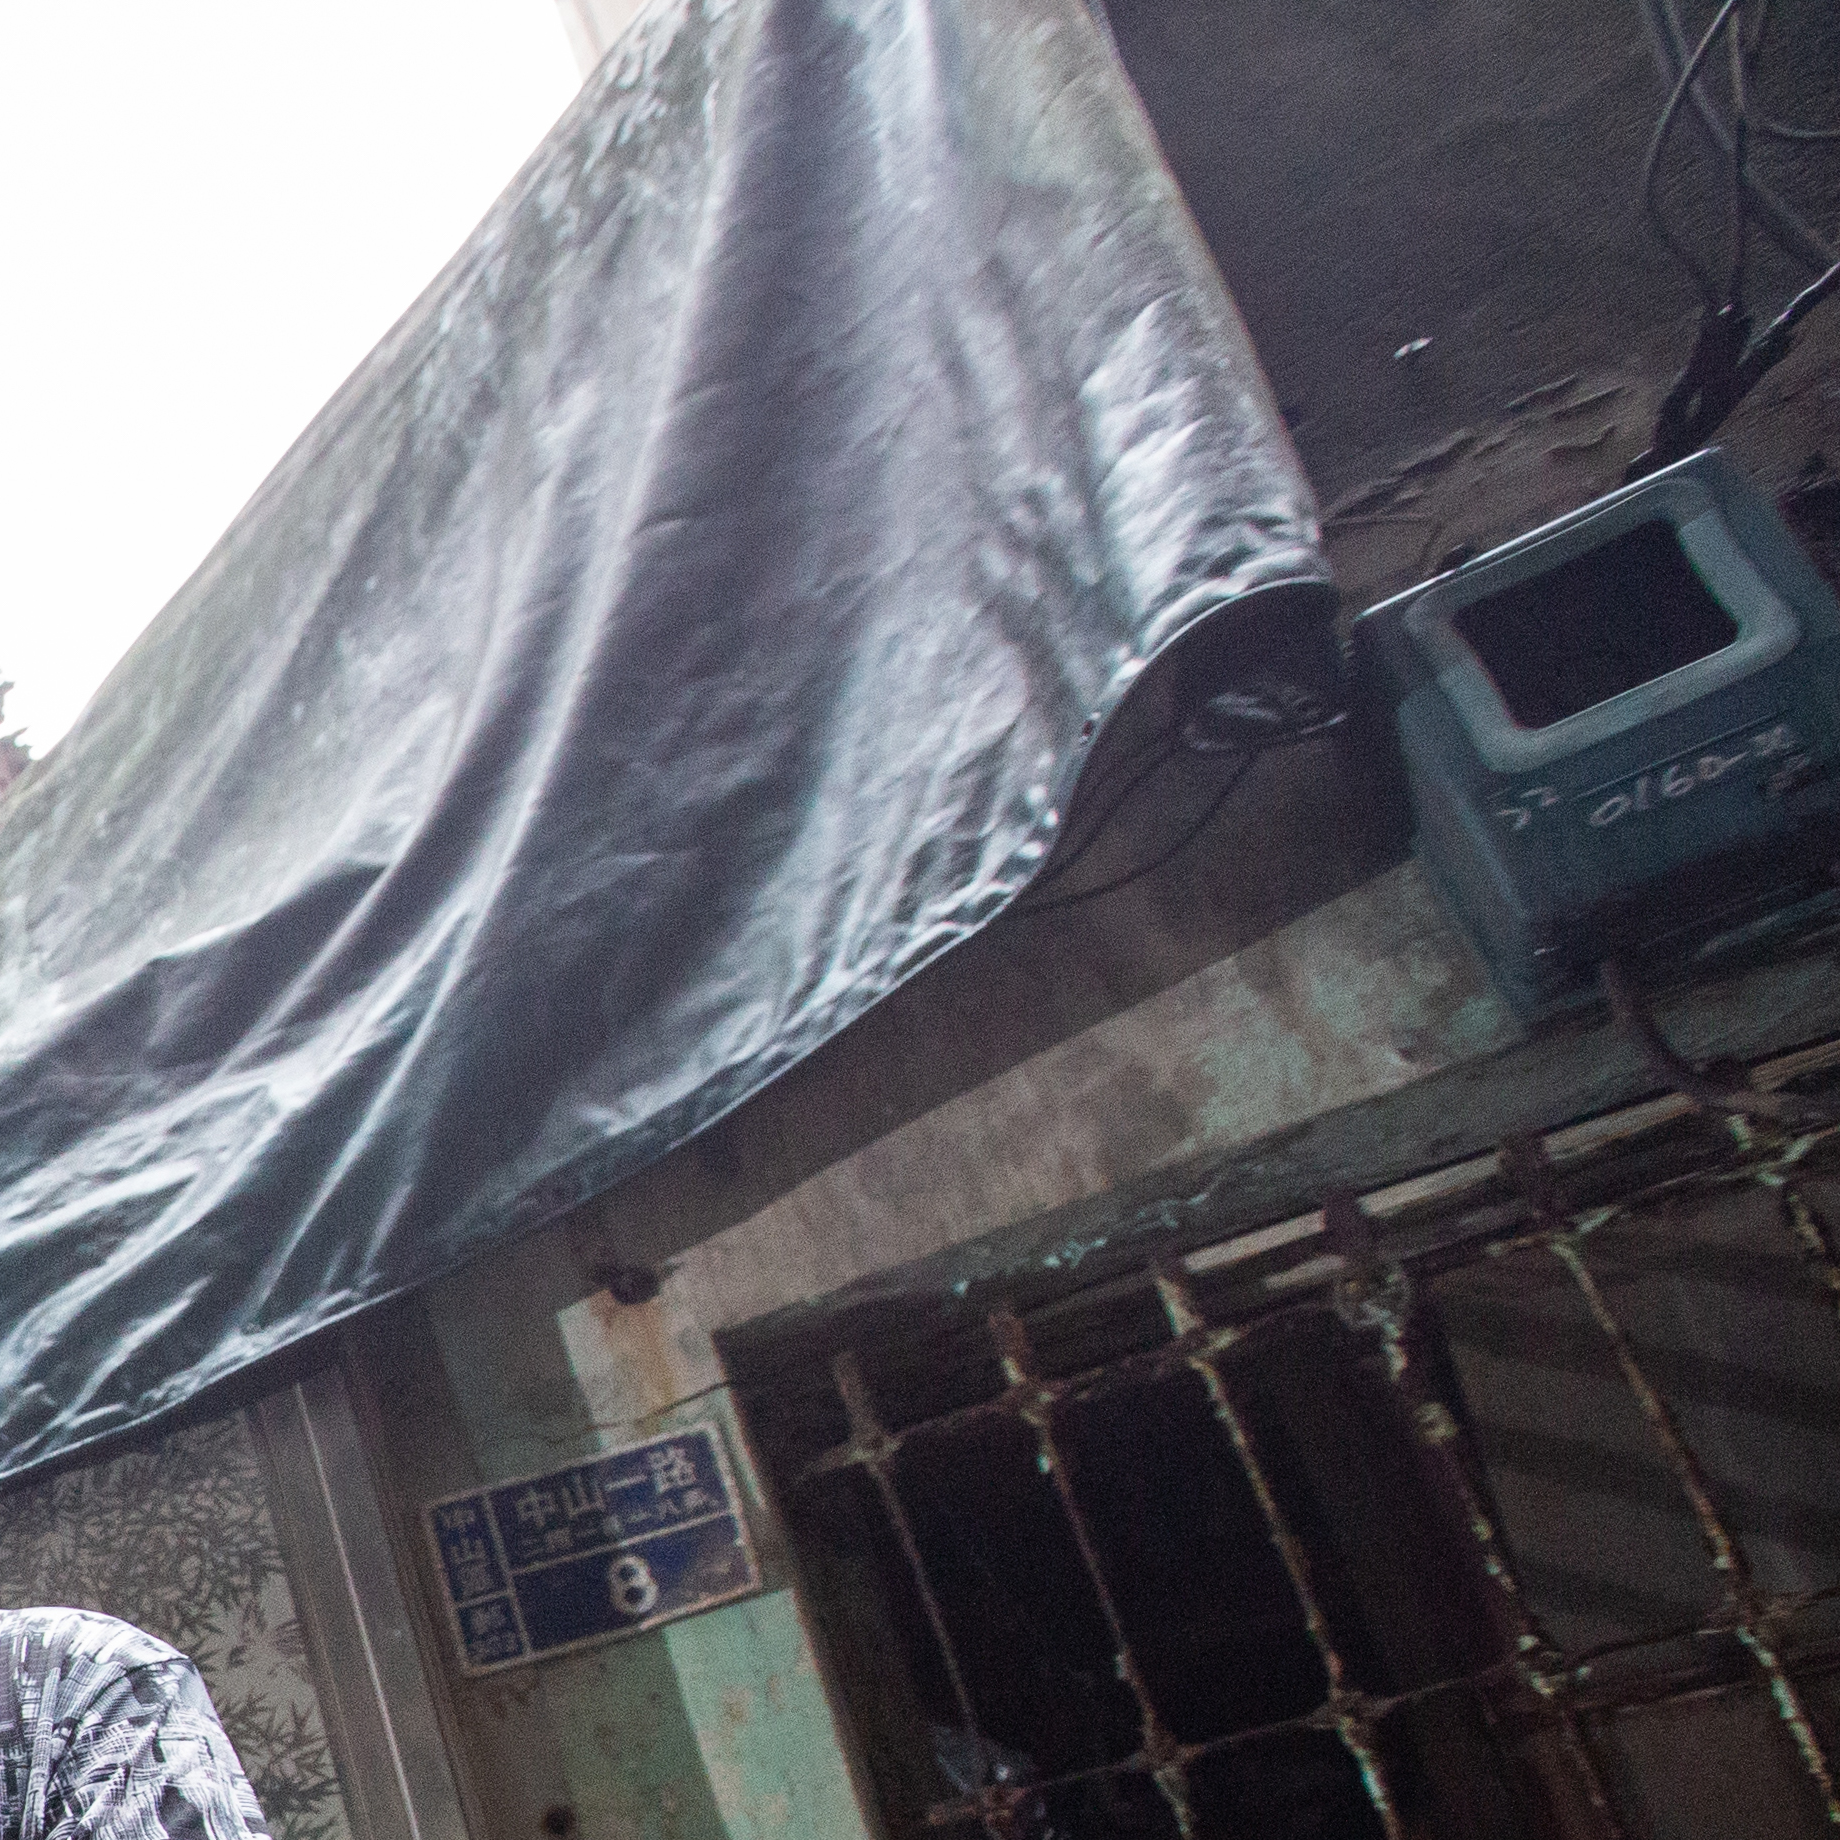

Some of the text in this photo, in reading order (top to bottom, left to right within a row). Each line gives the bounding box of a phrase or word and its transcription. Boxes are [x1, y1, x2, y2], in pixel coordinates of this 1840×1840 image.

[515, 1445, 698, 1527] 中山一路
[609, 1553, 661, 1616] 8
